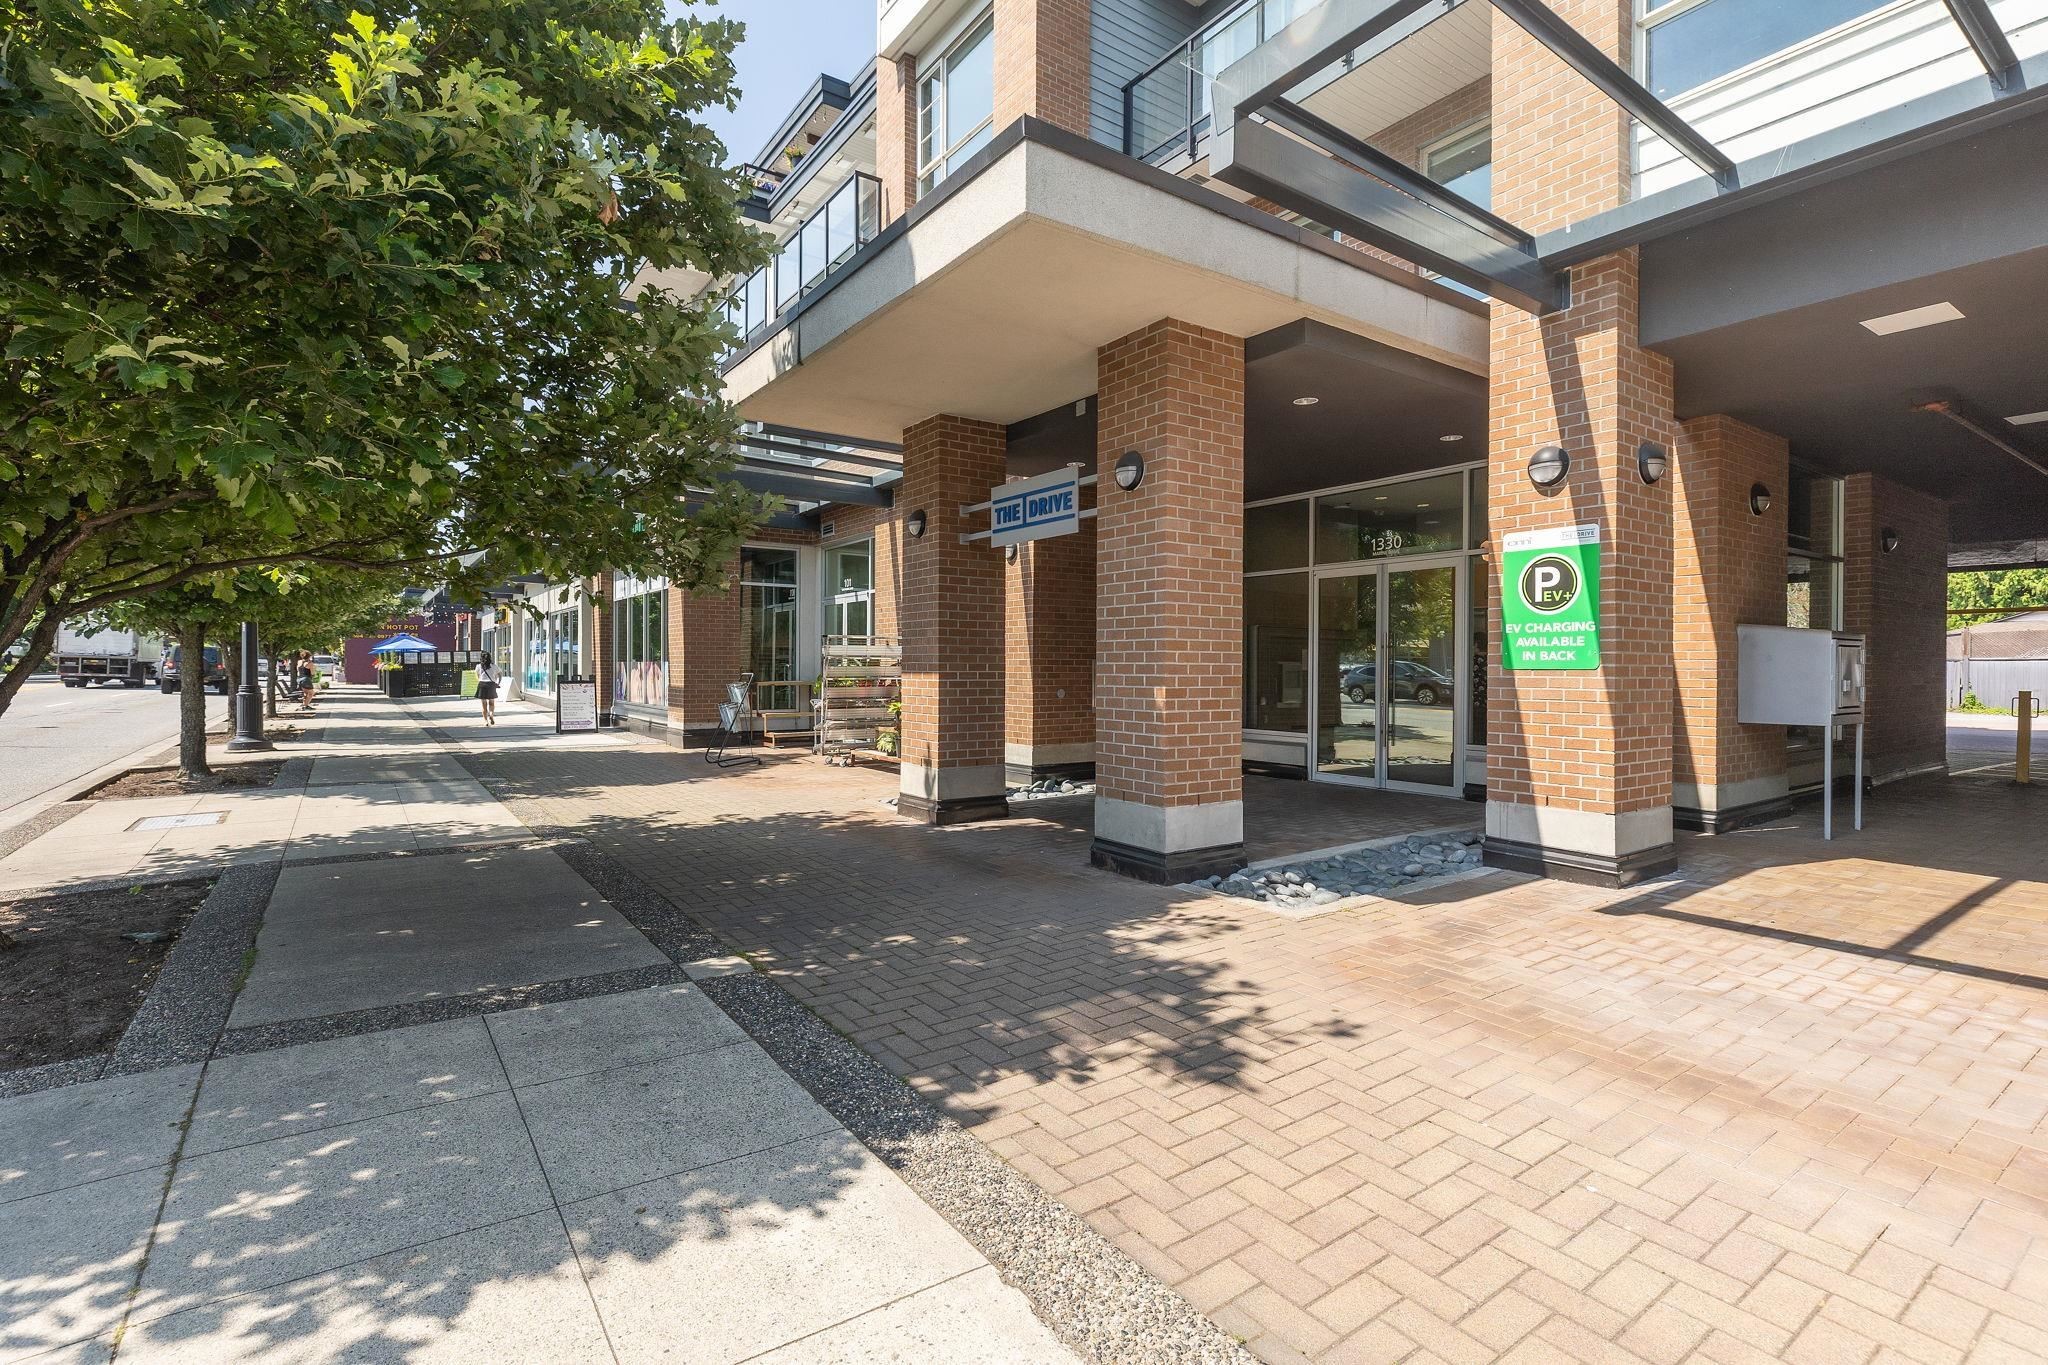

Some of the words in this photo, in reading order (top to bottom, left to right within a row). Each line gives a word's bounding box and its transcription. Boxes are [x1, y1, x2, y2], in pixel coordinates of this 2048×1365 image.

[994, 503, 1020, 524] THE
[1029, 490, 1072, 518] DRIVE
[1577, 530, 1595, 538] DRIVE
[1371, 535, 1402, 551] 1330
[1534, 566, 1561, 603] P
[1505, 623, 1523, 634] EV
[1525, 621, 1596, 634] CHARGING
[1516, 636, 1585, 647] AVAILABLE
[1522, 651, 1536, 661] IN
[1540, 651, 1576, 661] BACK
